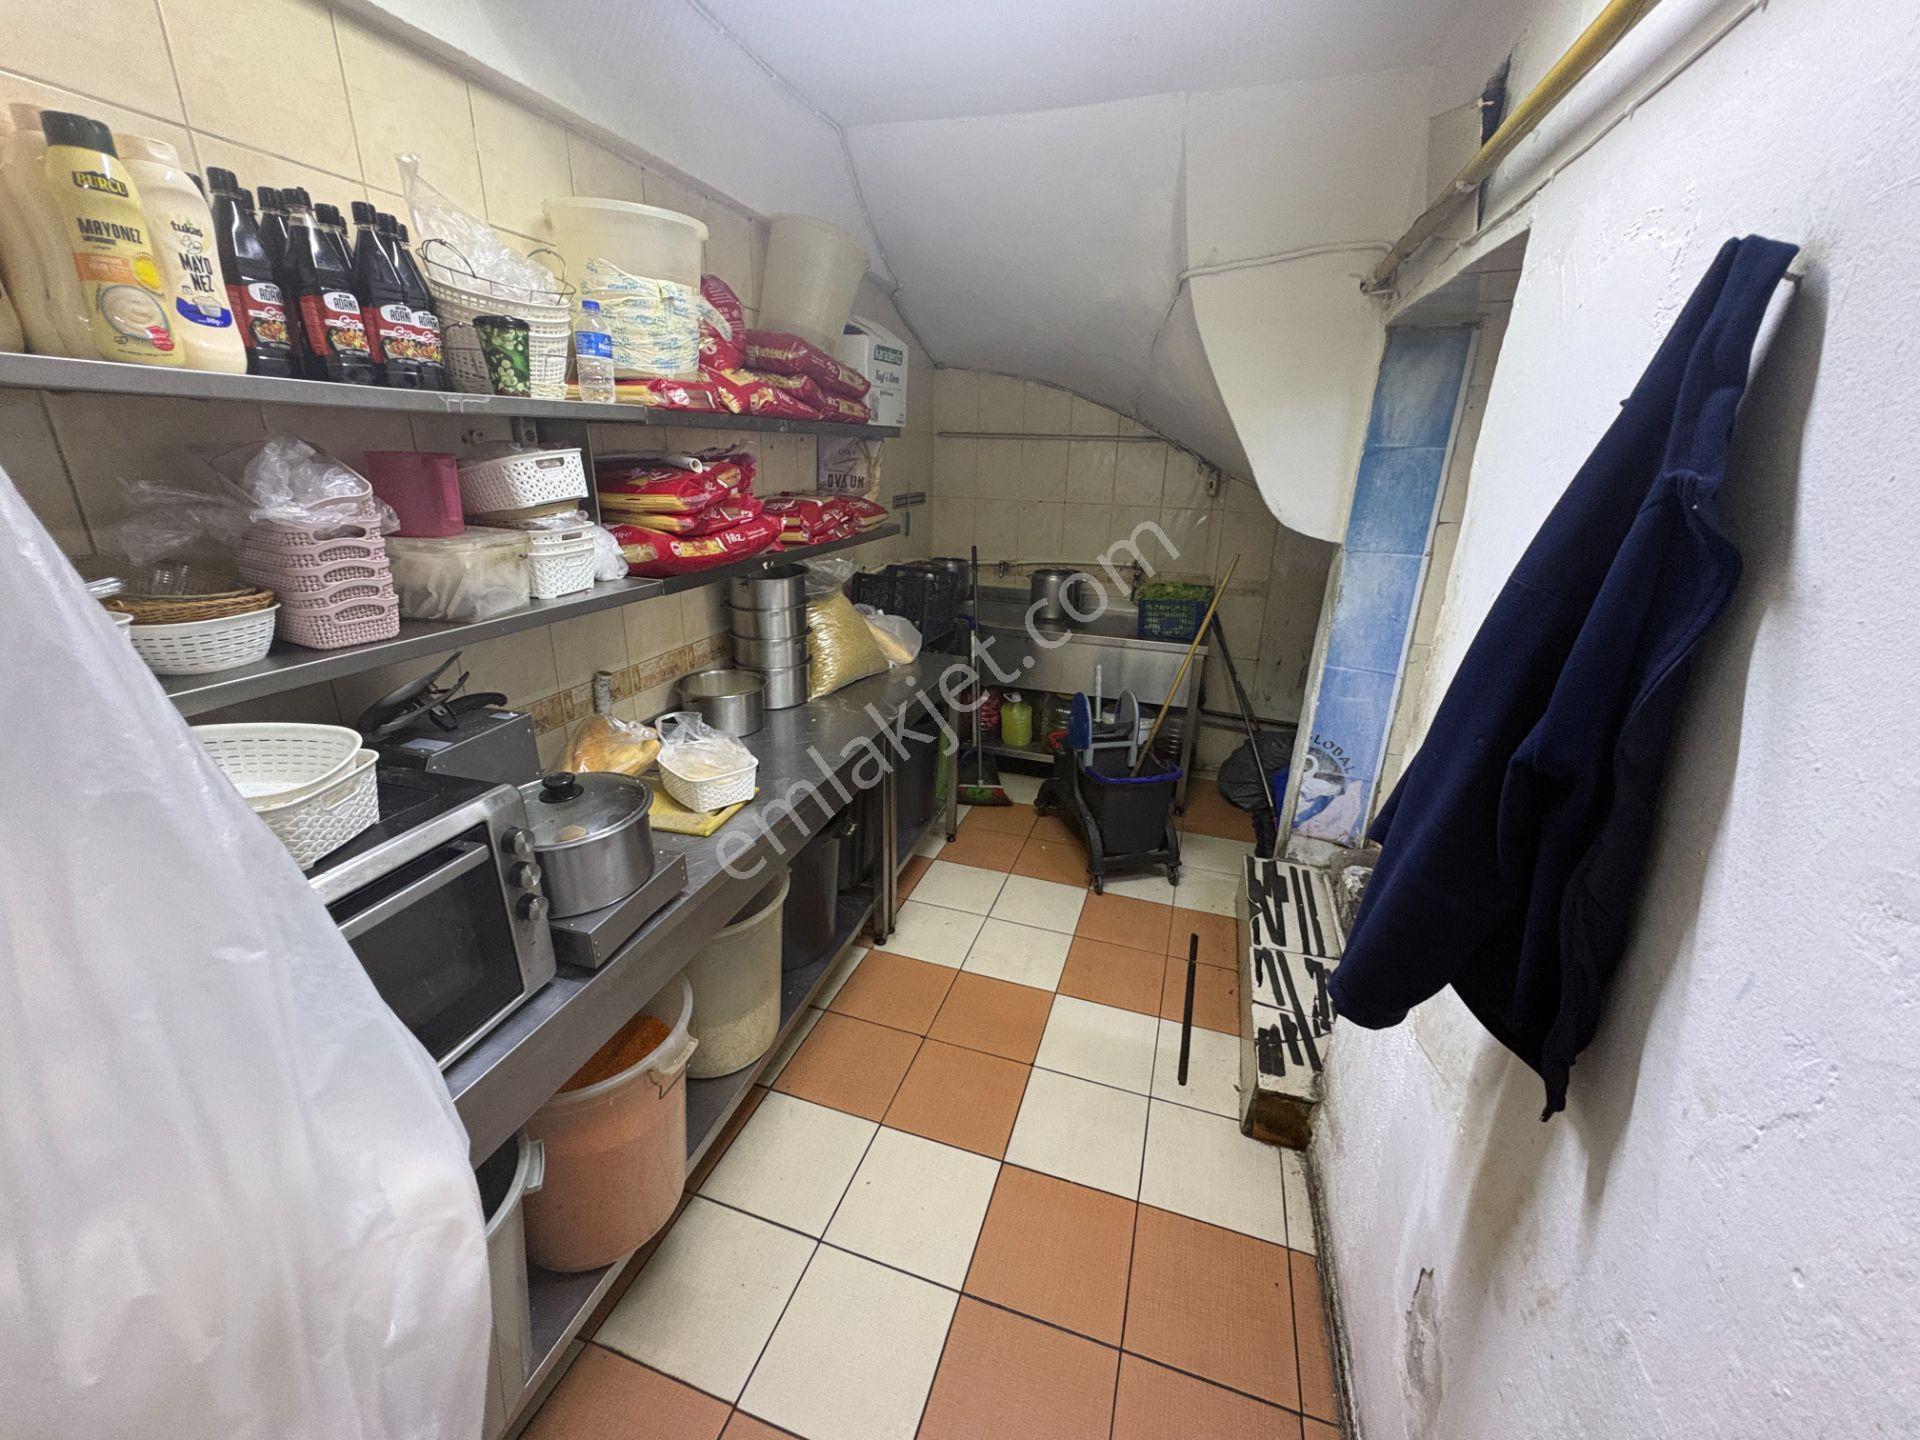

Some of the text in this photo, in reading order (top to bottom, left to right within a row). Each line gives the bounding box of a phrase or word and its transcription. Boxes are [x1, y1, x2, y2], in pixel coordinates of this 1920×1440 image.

[76, 217, 143, 245] MAYONEZ
[178, 252, 213, 275] MAYO
[190, 273, 215, 293] NEZ
[1310, 732, 1355, 774] LOBAL
